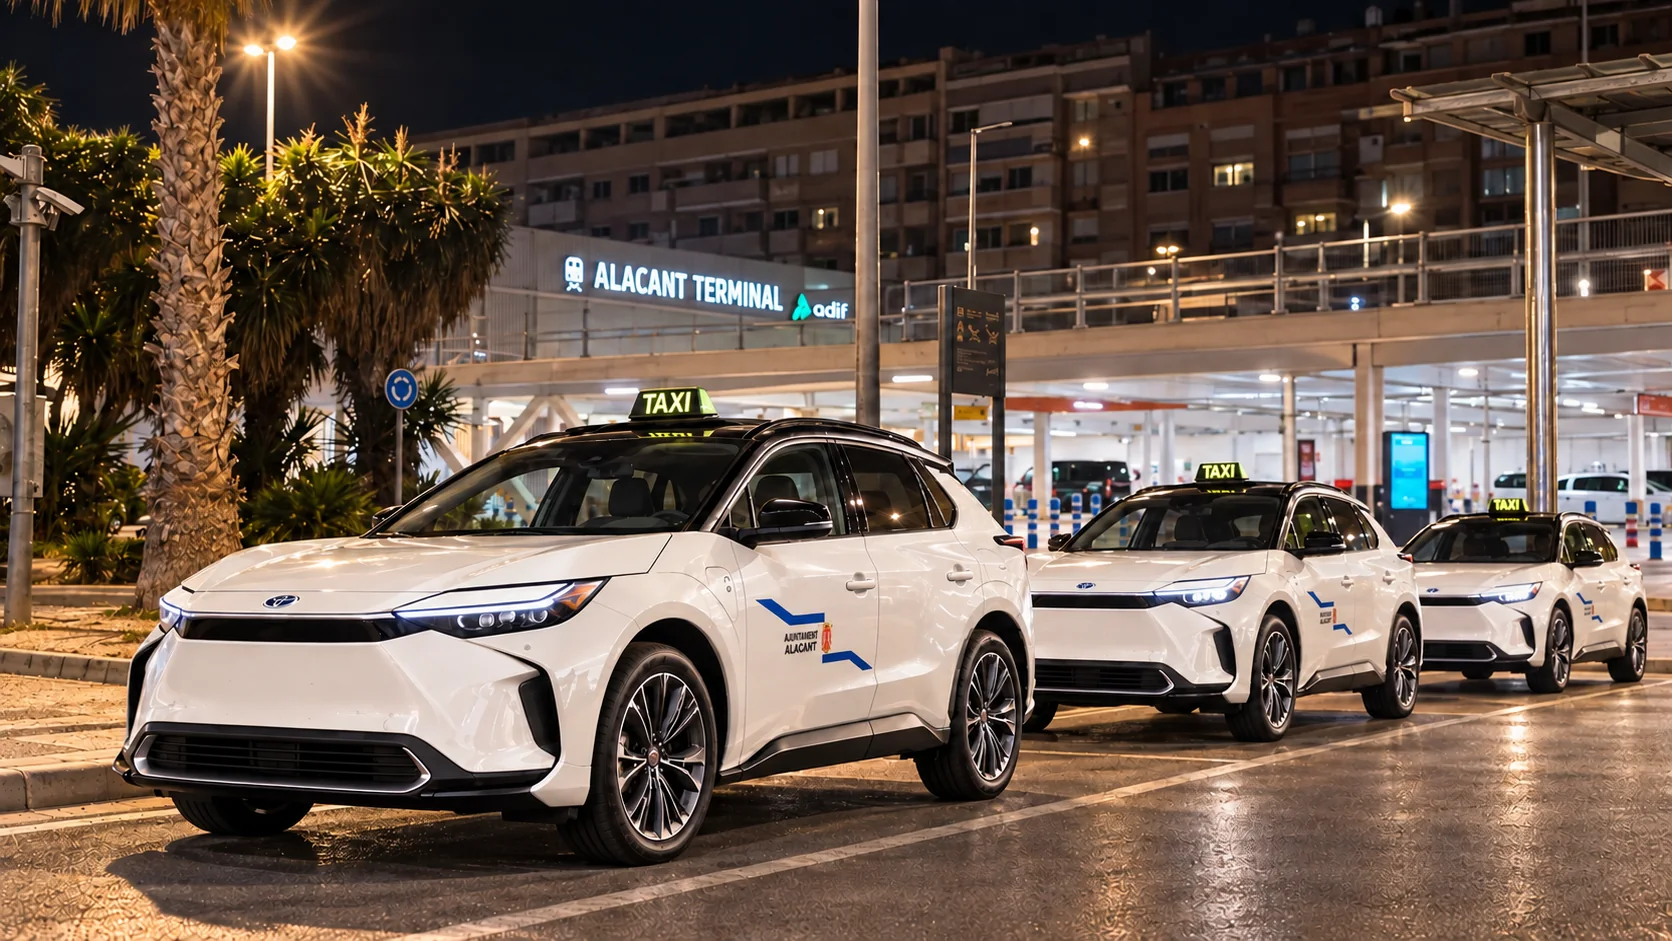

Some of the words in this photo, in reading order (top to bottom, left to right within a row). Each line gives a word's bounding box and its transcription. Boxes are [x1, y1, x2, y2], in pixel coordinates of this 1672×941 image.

[594, 261, 688, 299] ALACANT
[692, 274, 784, 312] TERMINAL
[812, 301, 849, 320] adif
[642, 391, 692, 415] TAXI
[1202, 463, 1236, 479] TAXI
[1493, 499, 1520, 511] TAXI
[784, 641, 817, 655] ALACANT
